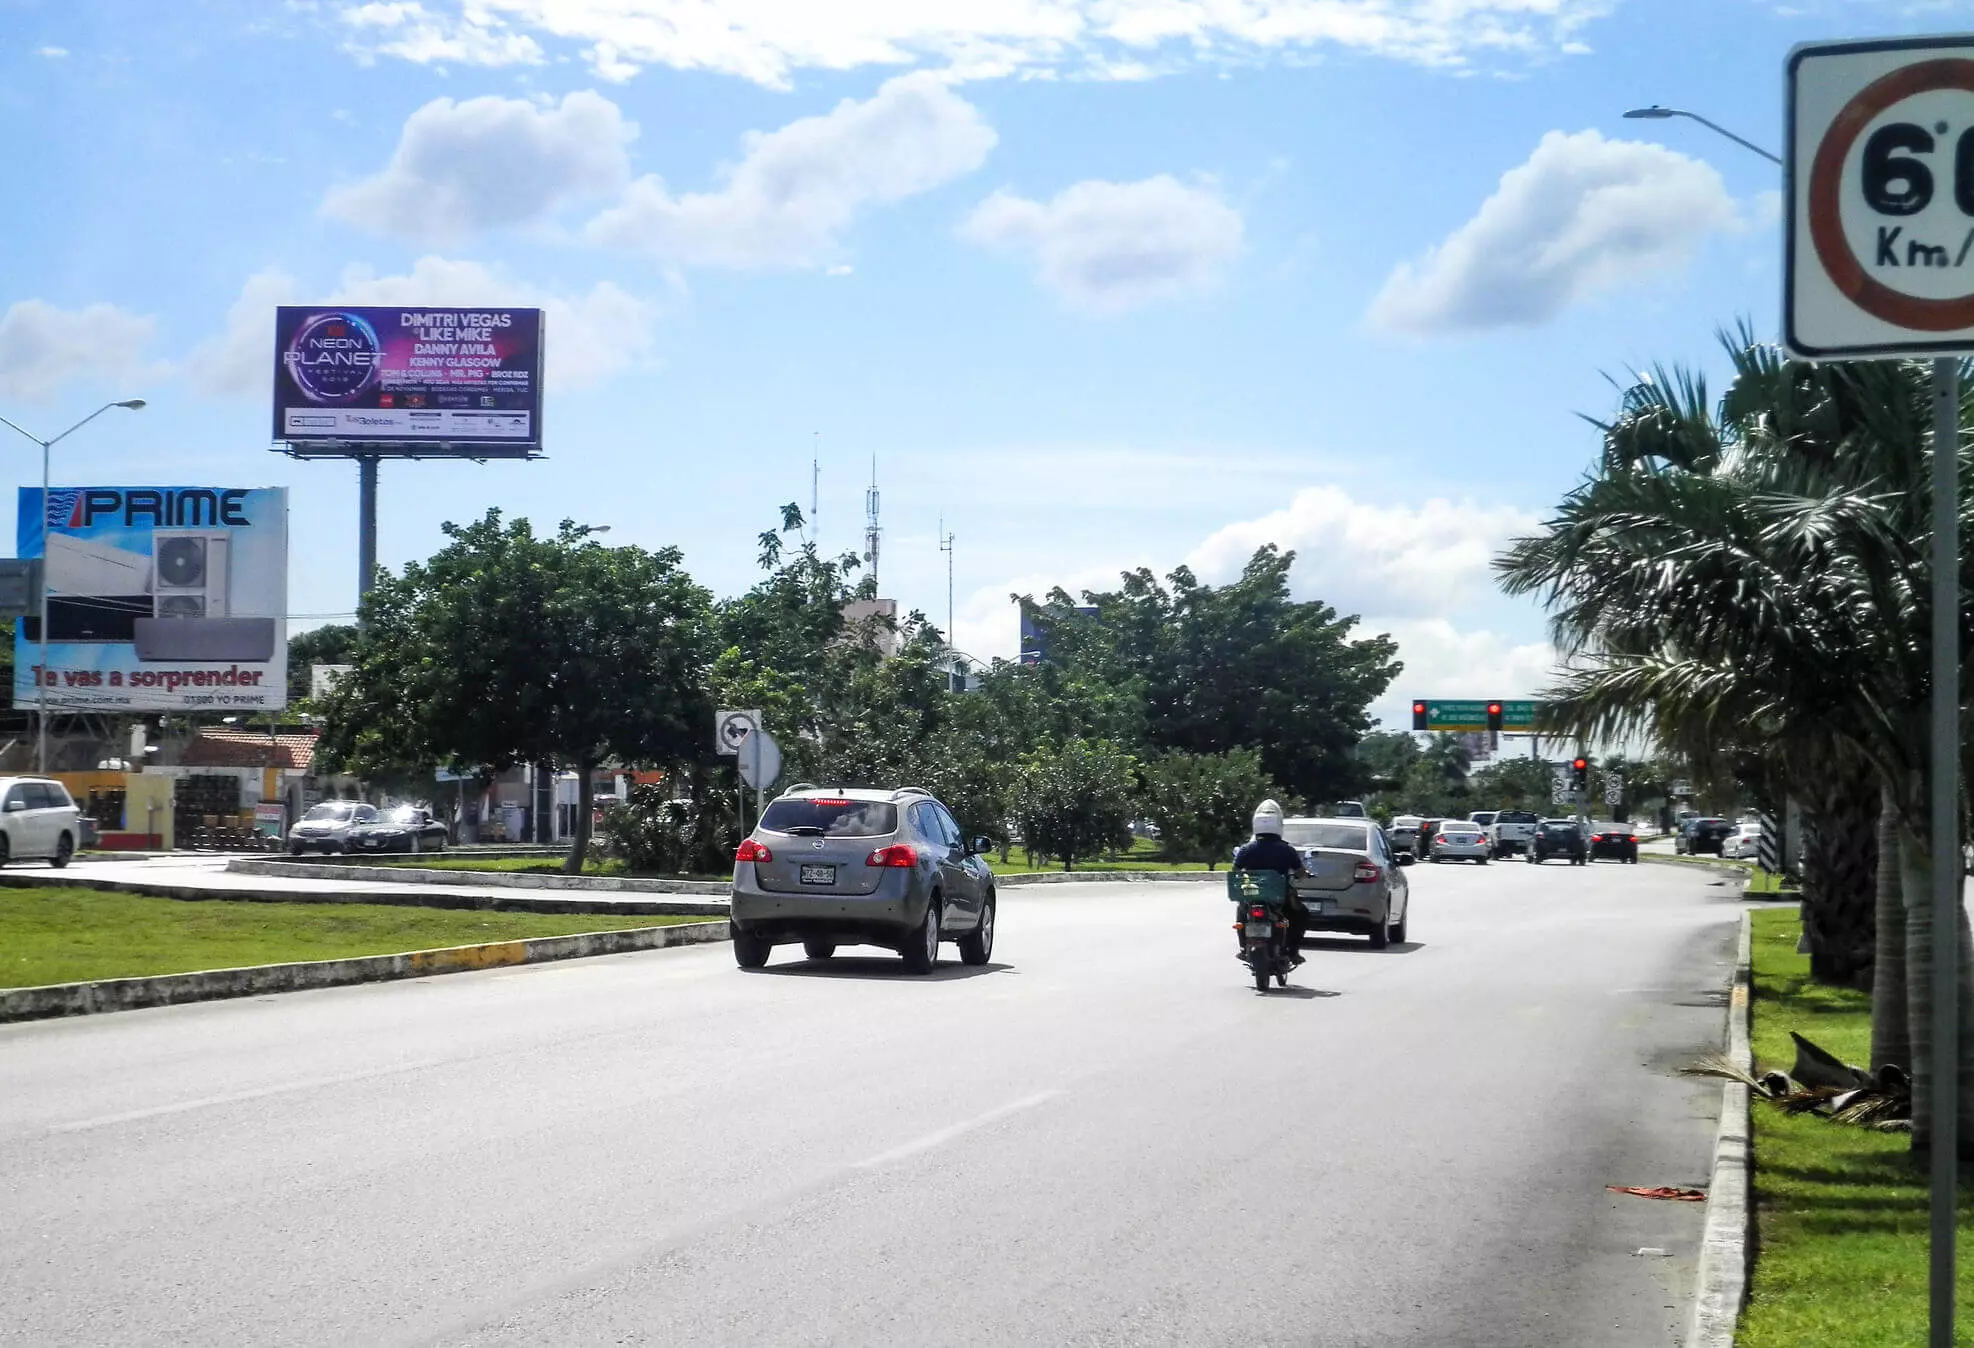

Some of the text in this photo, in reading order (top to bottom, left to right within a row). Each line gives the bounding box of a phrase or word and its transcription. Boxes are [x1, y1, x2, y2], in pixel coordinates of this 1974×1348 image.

[1861, 122, 1974, 217] 6
[400, 312, 512, 327] DIMITRI VEGAS
[419, 327, 456, 341] LIKE
[456, 327, 493, 341] MIKE
[310, 338, 362, 349] NEON
[413, 343, 497, 355] DANNY AVILA
[283, 351, 387, 366] PLANET
[408, 357, 502, 368] KENNY GLASGOW
[84, 490, 251, 527] PRIME
[64, 670, 102, 687] vas
[109, 671, 122, 687] a
[128, 664, 264, 693] sorprender
[233, 695, 265, 705] PRIME
